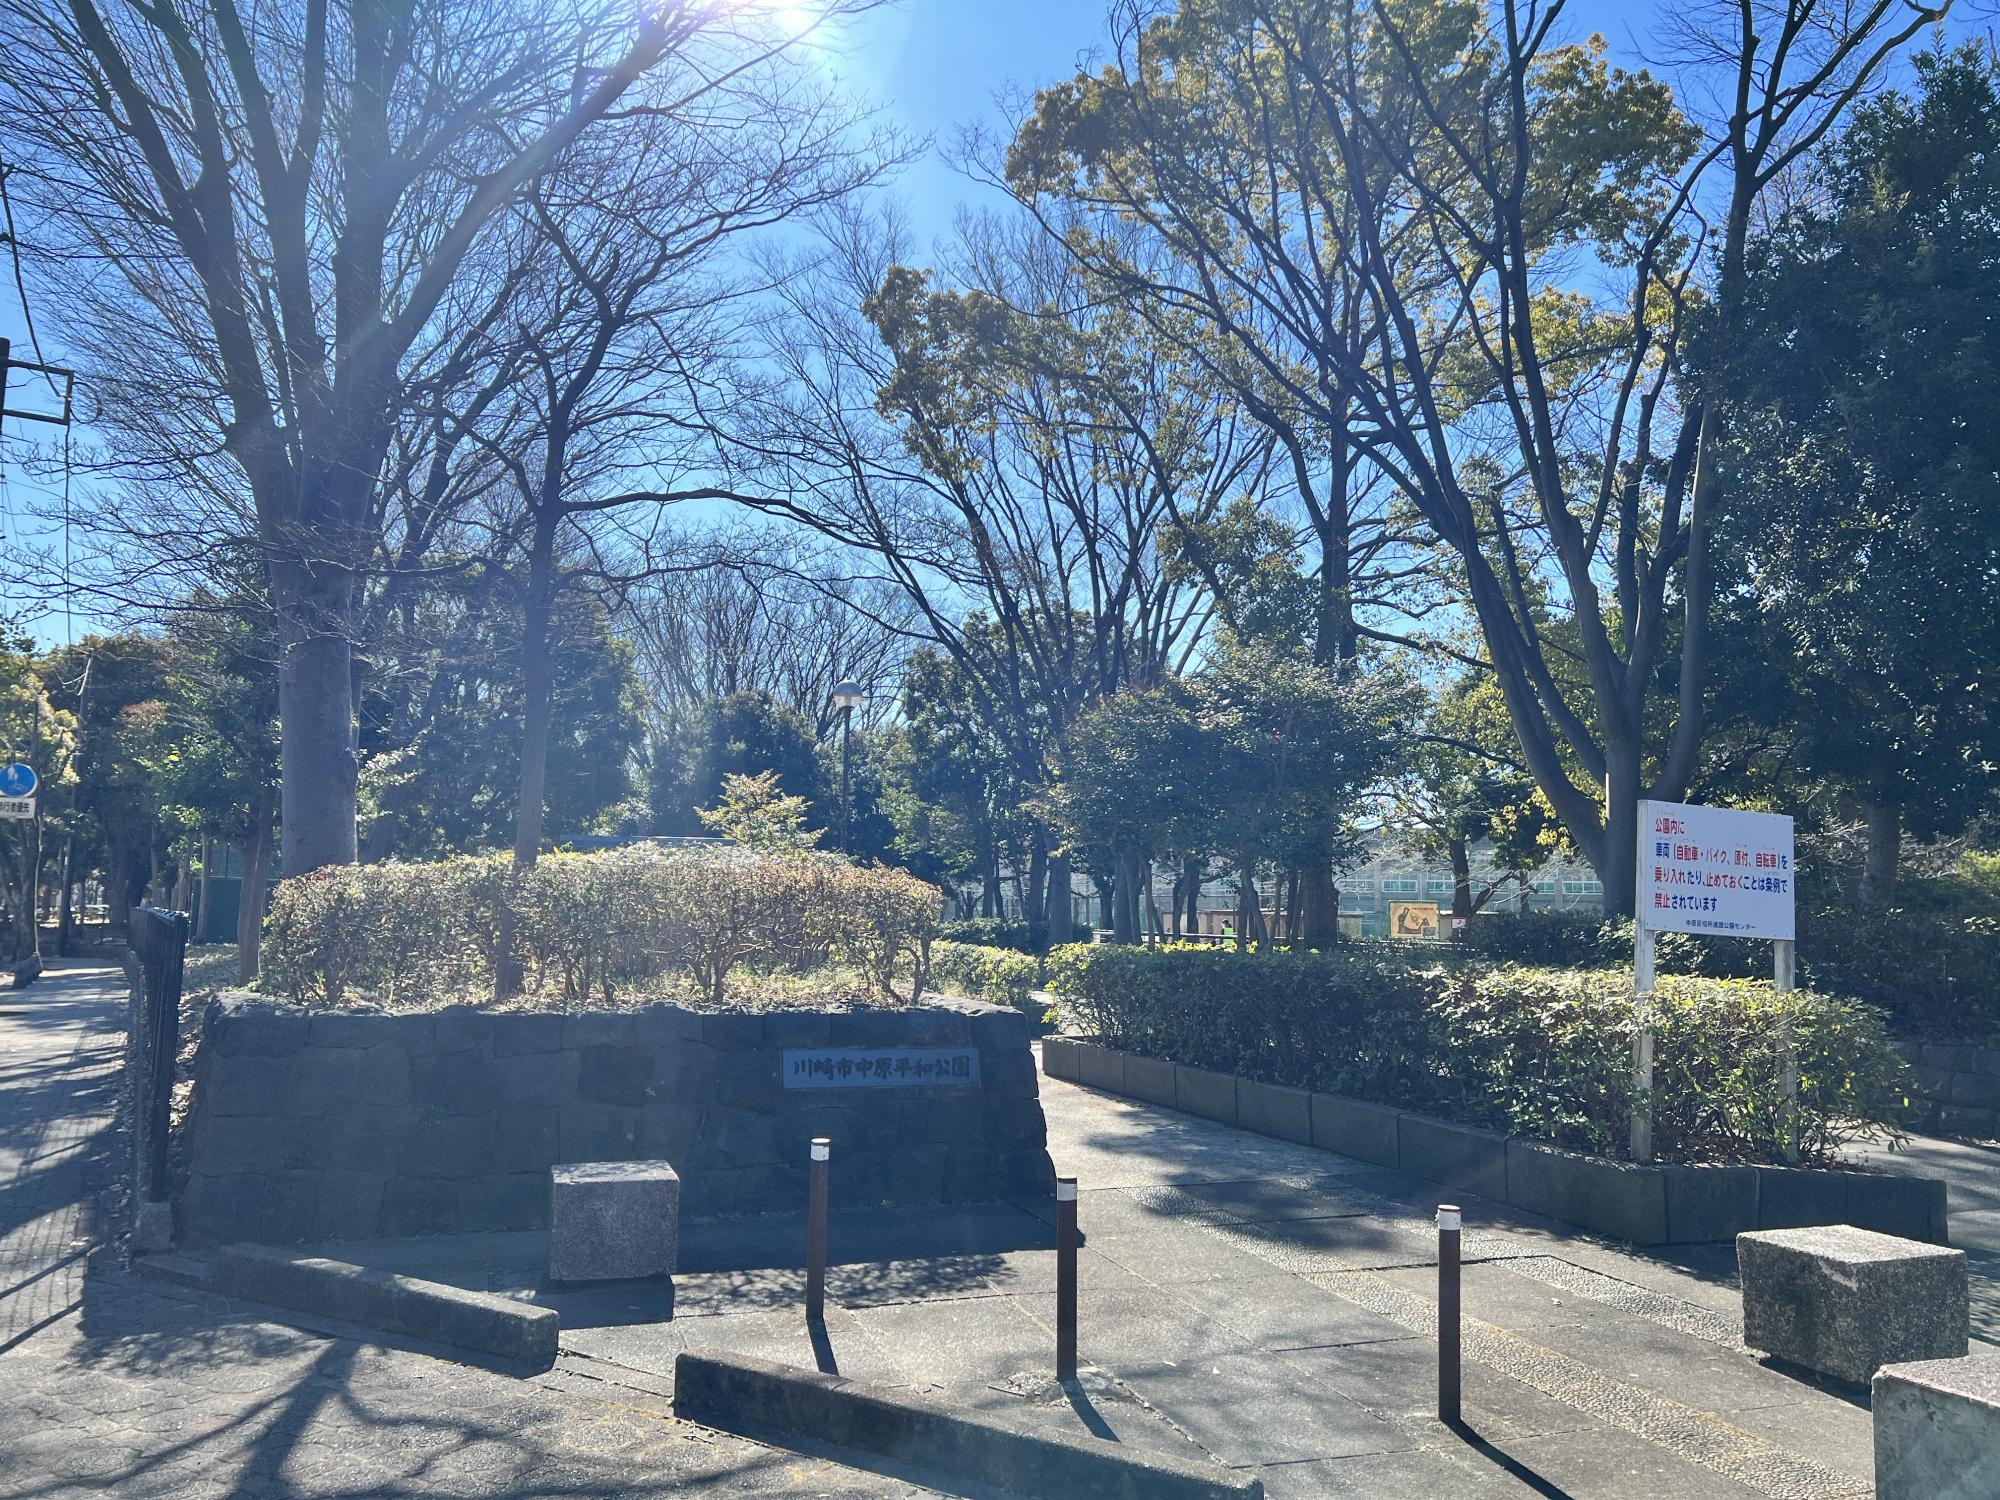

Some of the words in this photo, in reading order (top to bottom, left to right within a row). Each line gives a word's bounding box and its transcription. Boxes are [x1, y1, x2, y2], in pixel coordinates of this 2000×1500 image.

[1655, 818, 1685, 835] 公園内に
[1654, 867, 1788, 894] 乗り入れたり、止めておくことは条例で
[1654, 892, 1718, 912] 禁止されています
[793, 1055, 970, 1081] 川崎市中原平和公園
